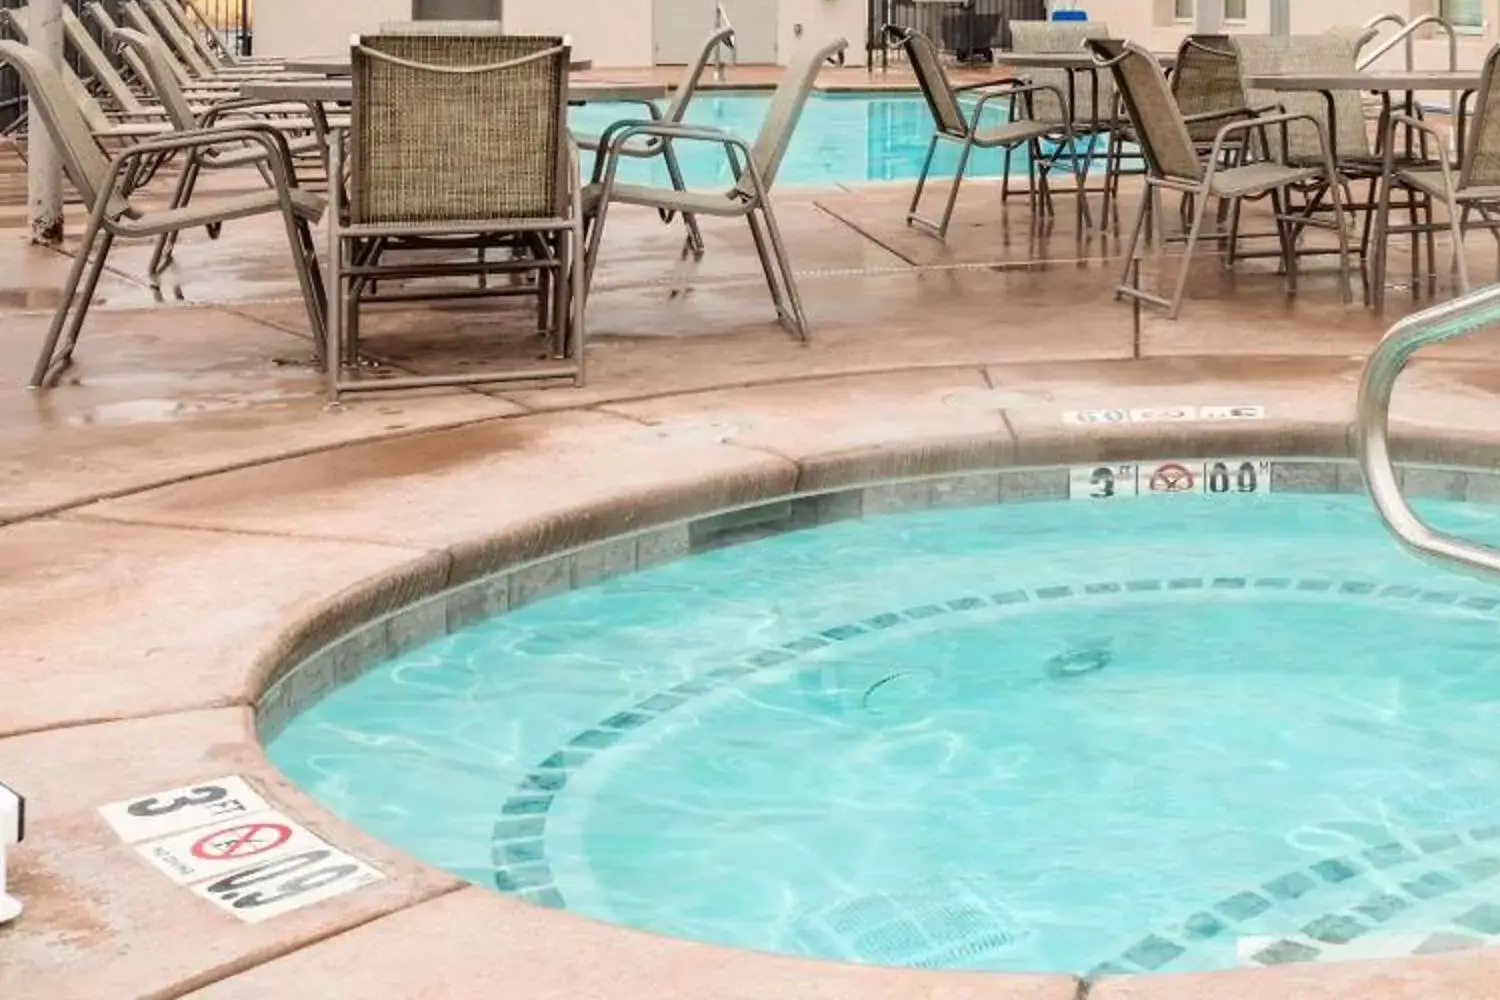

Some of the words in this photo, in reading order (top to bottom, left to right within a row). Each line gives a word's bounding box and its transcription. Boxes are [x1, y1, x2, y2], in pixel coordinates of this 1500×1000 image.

[1089, 467, 1115, 498] 3
[127, 785, 228, 816] 3
[207, 849, 359, 909] 0.9
